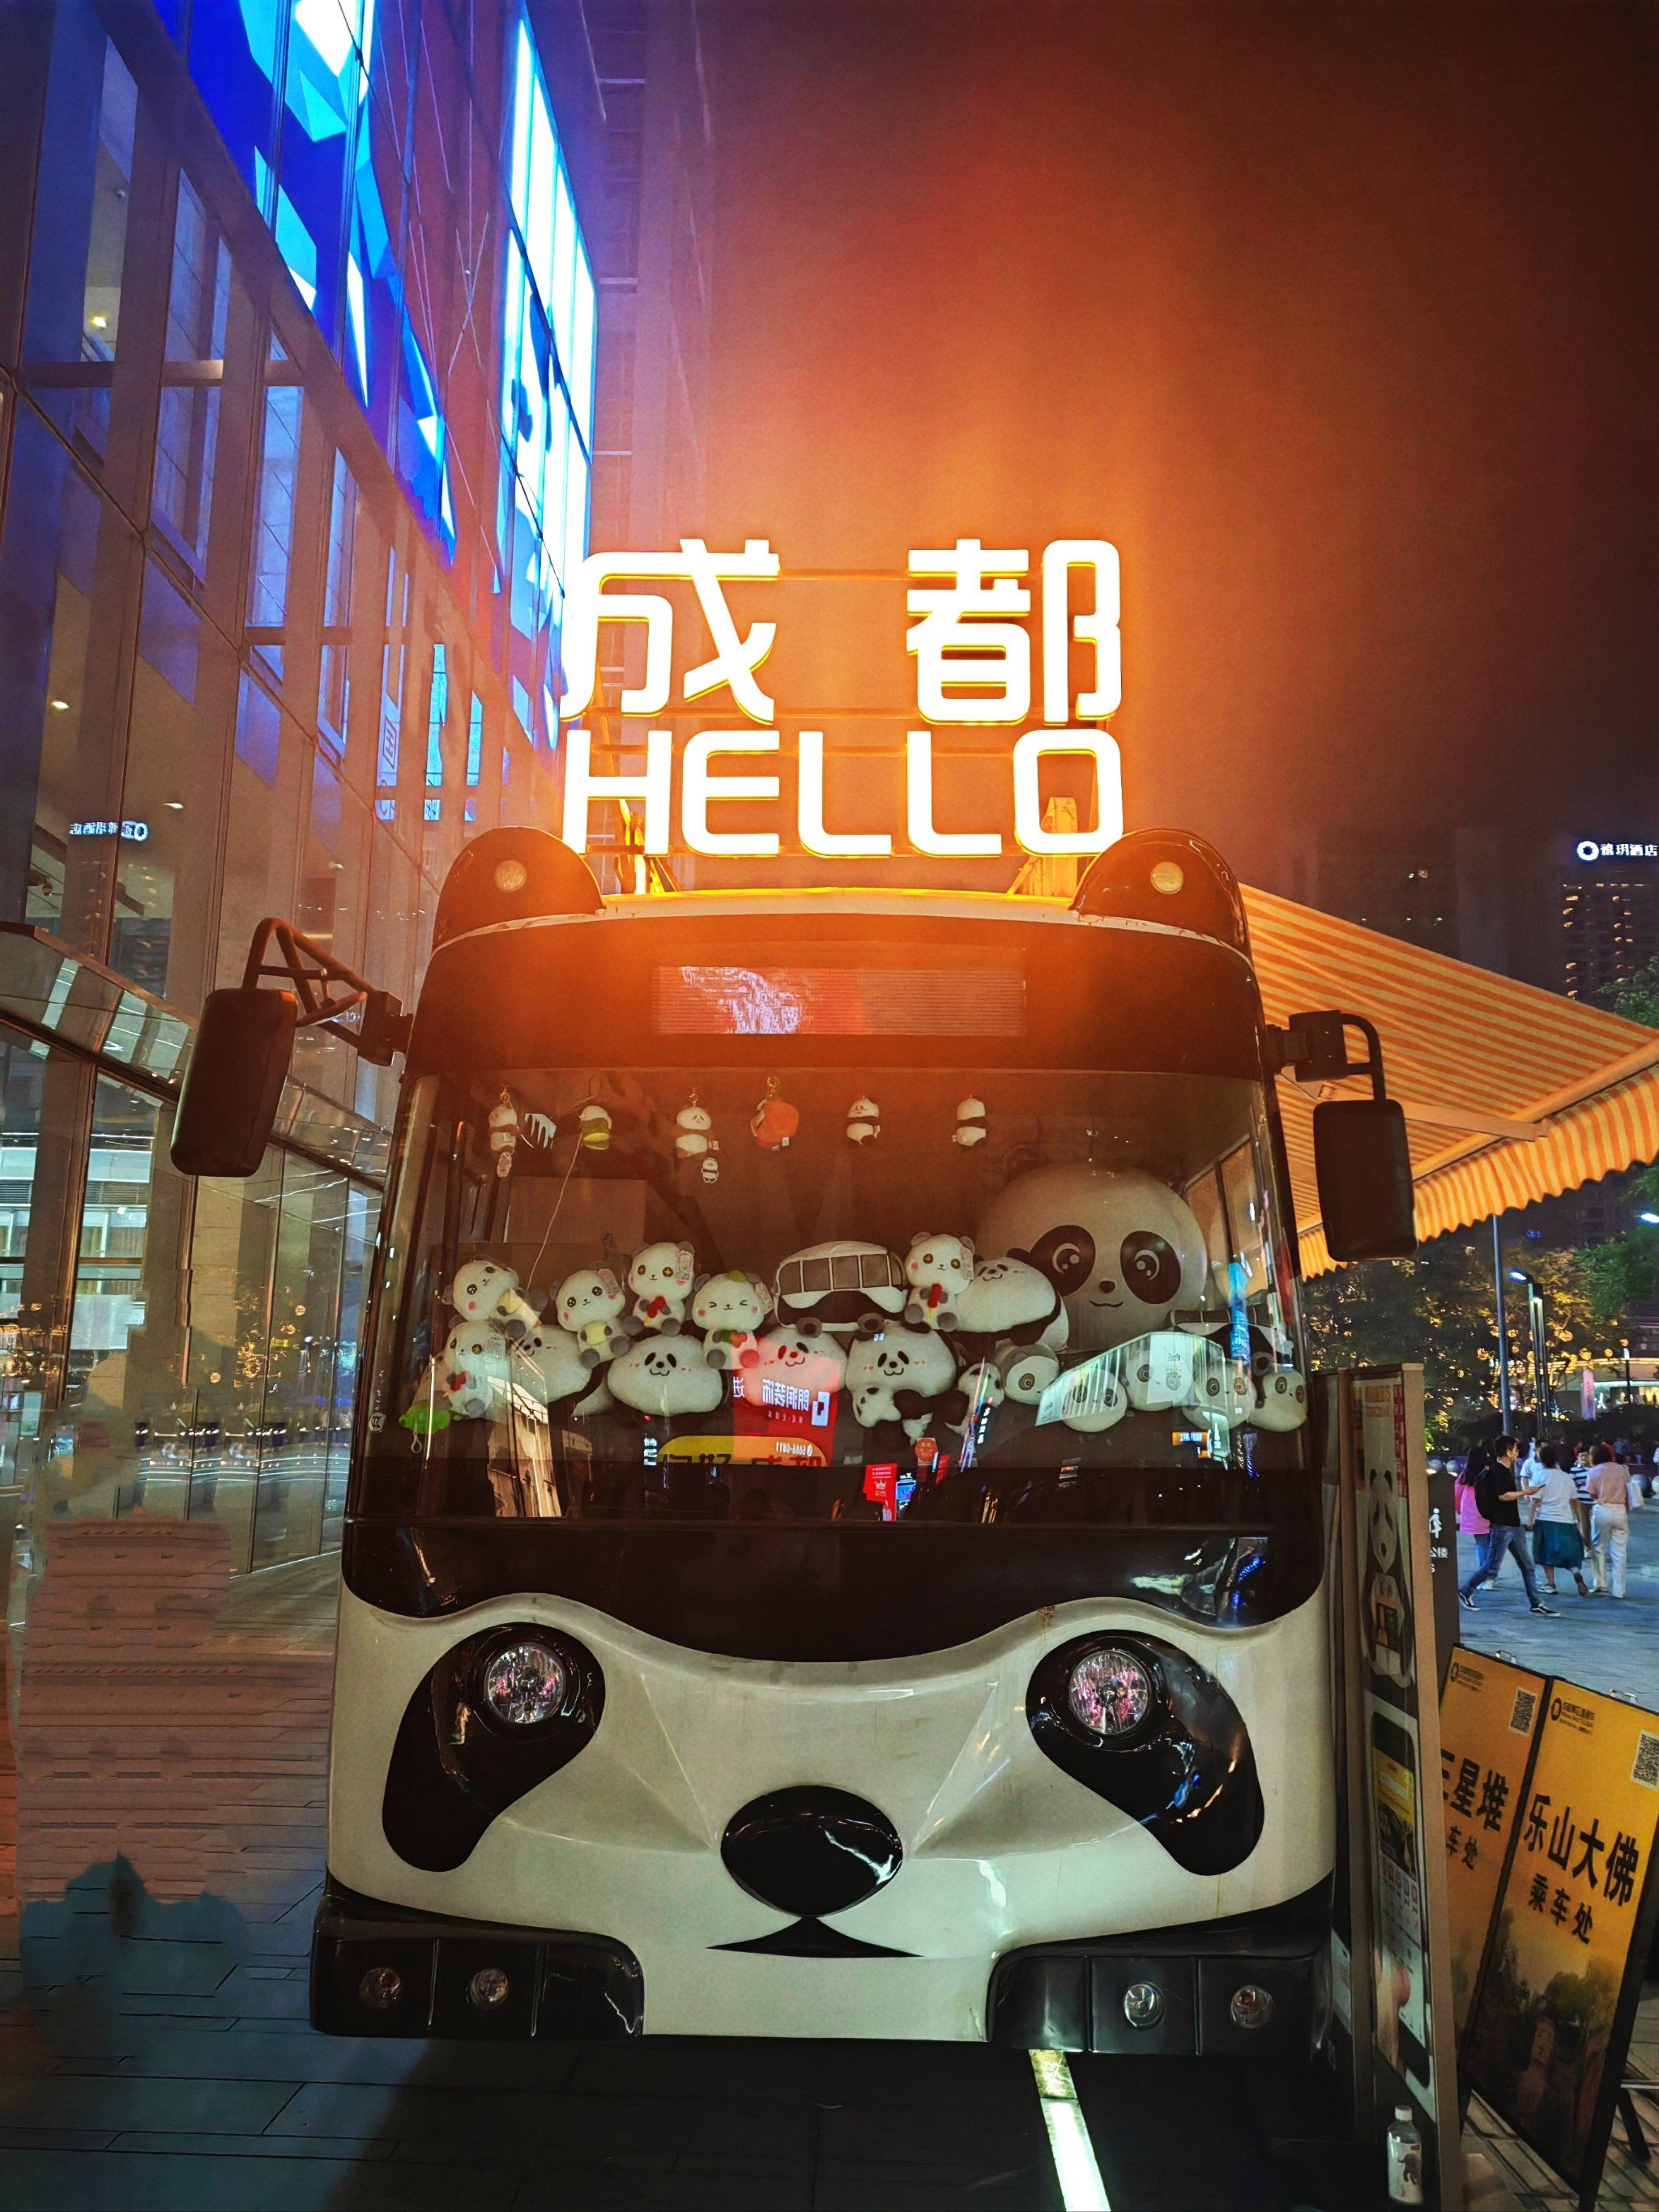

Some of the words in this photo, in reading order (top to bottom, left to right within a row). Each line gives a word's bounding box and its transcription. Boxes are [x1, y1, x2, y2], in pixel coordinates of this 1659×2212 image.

[561, 539, 1123, 725] 成都
[562, 728, 1124, 858] HELLO
[1523, 1792, 1640, 1907] 乐山大佛
[1528, 1872, 1593, 1945] 乘车处
